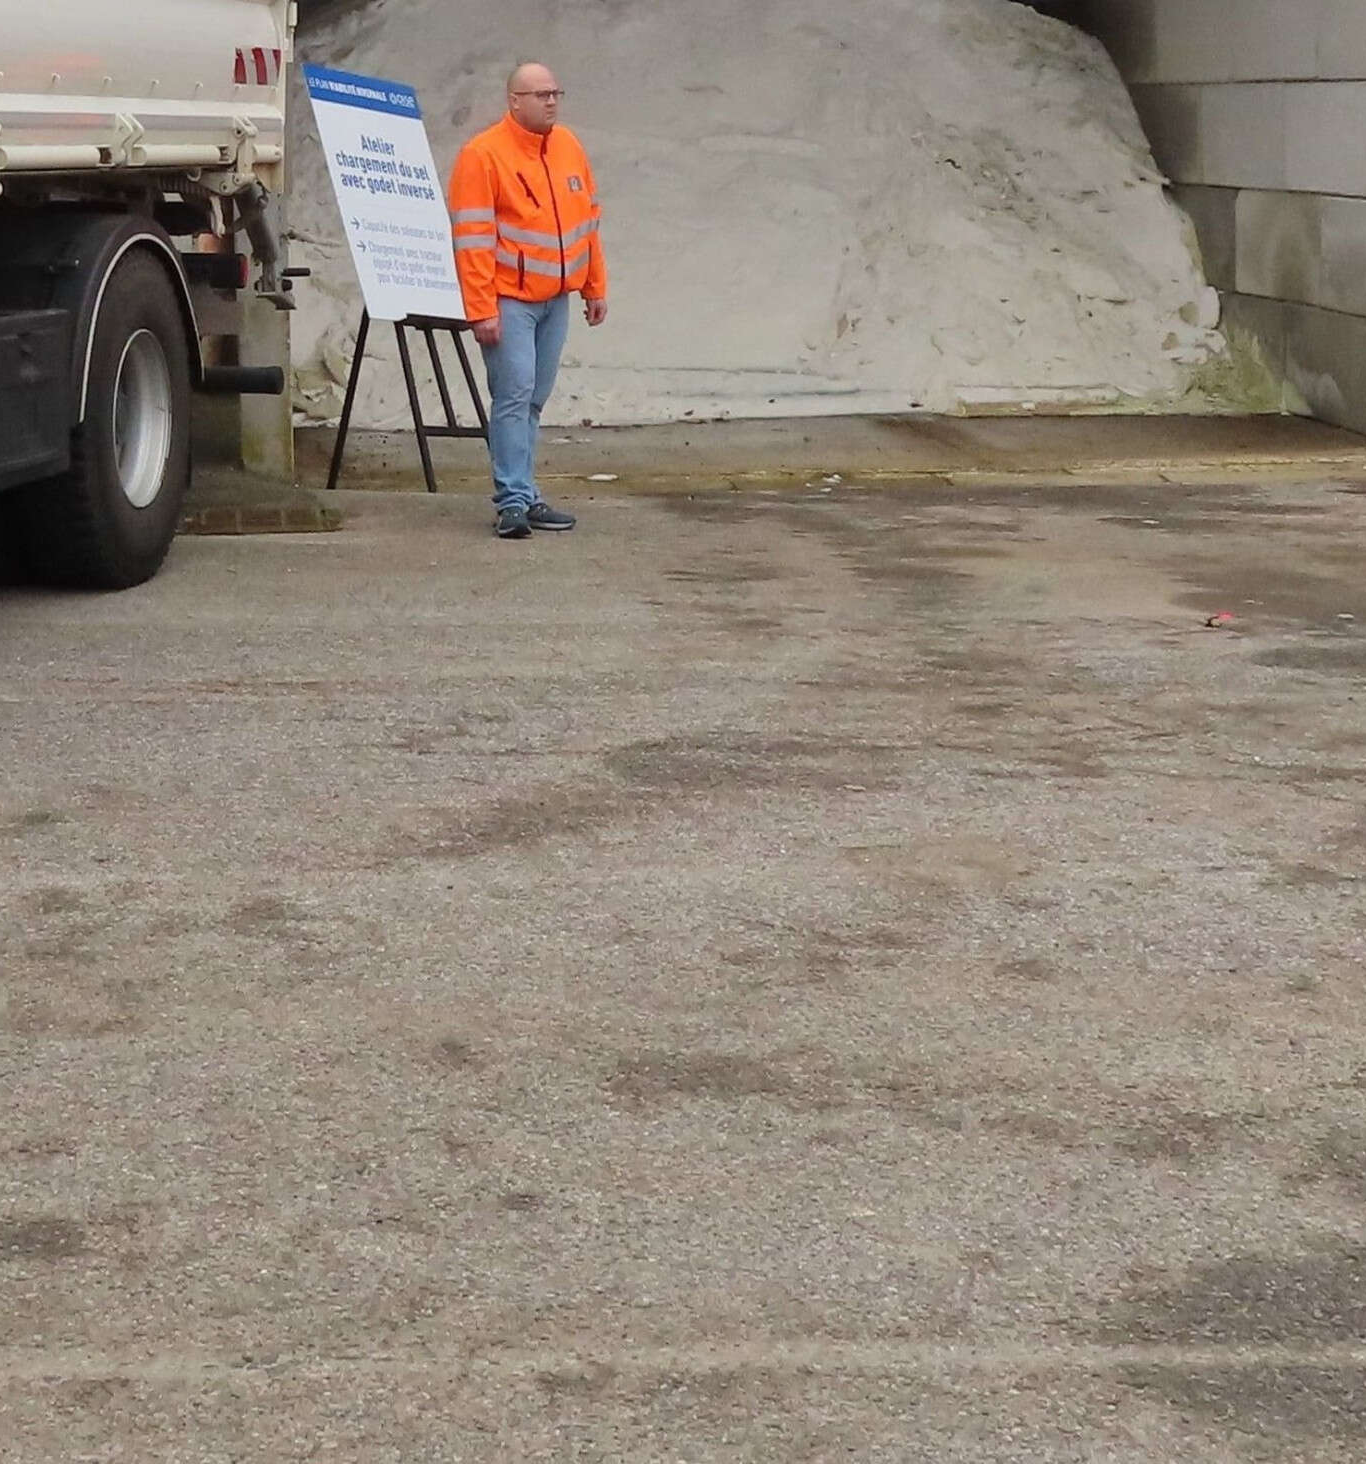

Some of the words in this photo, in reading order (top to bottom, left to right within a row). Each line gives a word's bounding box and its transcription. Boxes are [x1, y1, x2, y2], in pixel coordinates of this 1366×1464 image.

[360, 134, 395, 156] Atelier
[335, 150, 399, 174] chargement
[399, 160, 412, 178] du
[413, 165, 430, 182] sel
[340, 172, 366, 189] avec
[367, 175, 397, 195] godet
[396, 179, 436, 201] inversé
